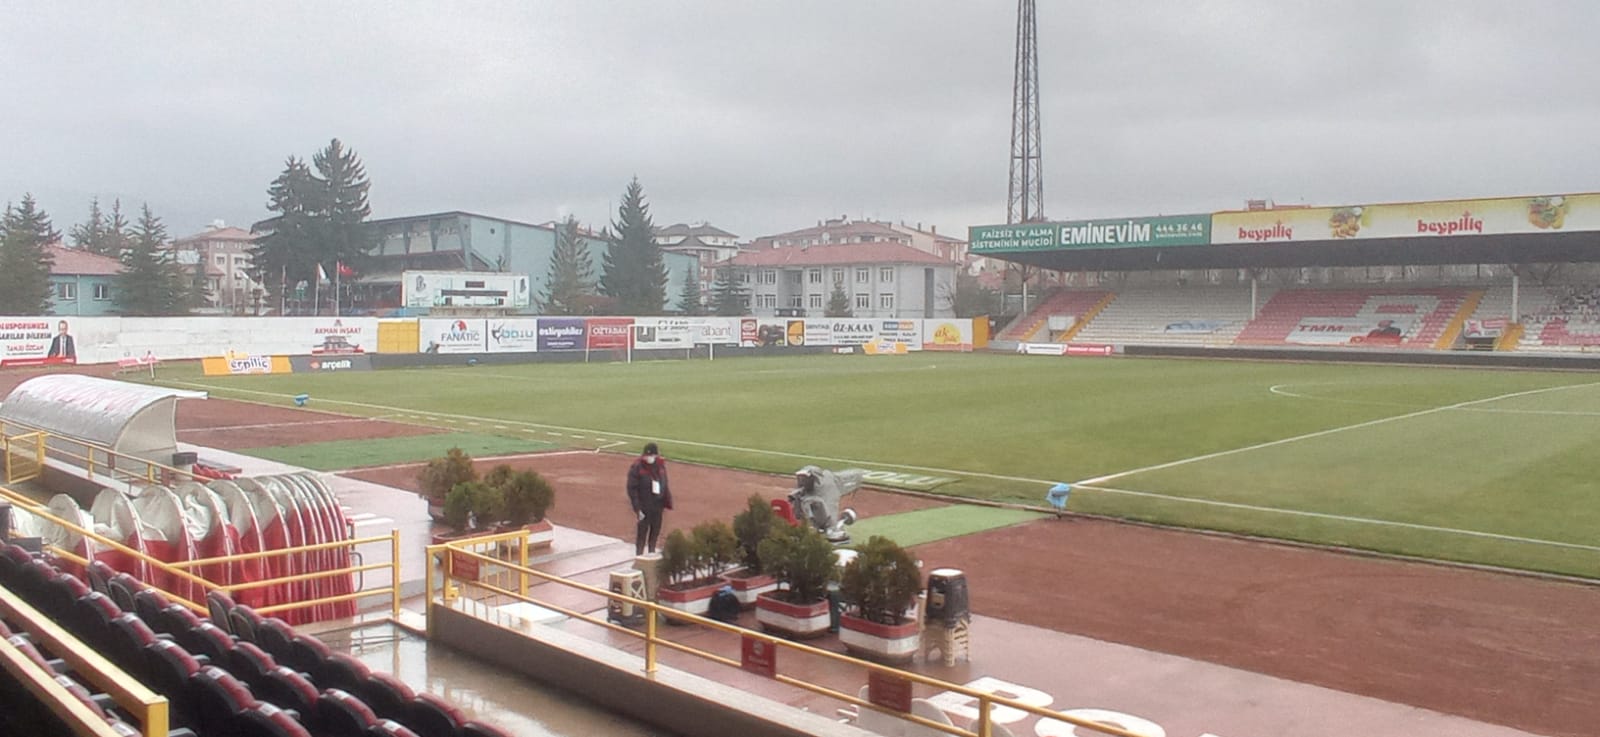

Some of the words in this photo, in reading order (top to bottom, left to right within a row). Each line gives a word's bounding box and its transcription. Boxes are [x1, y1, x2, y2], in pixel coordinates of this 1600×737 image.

[1028, 228, 1053, 237] ALMA
[1061, 220, 1151, 245] EMİNEVİM
[1155, 224, 1174, 233] 444
